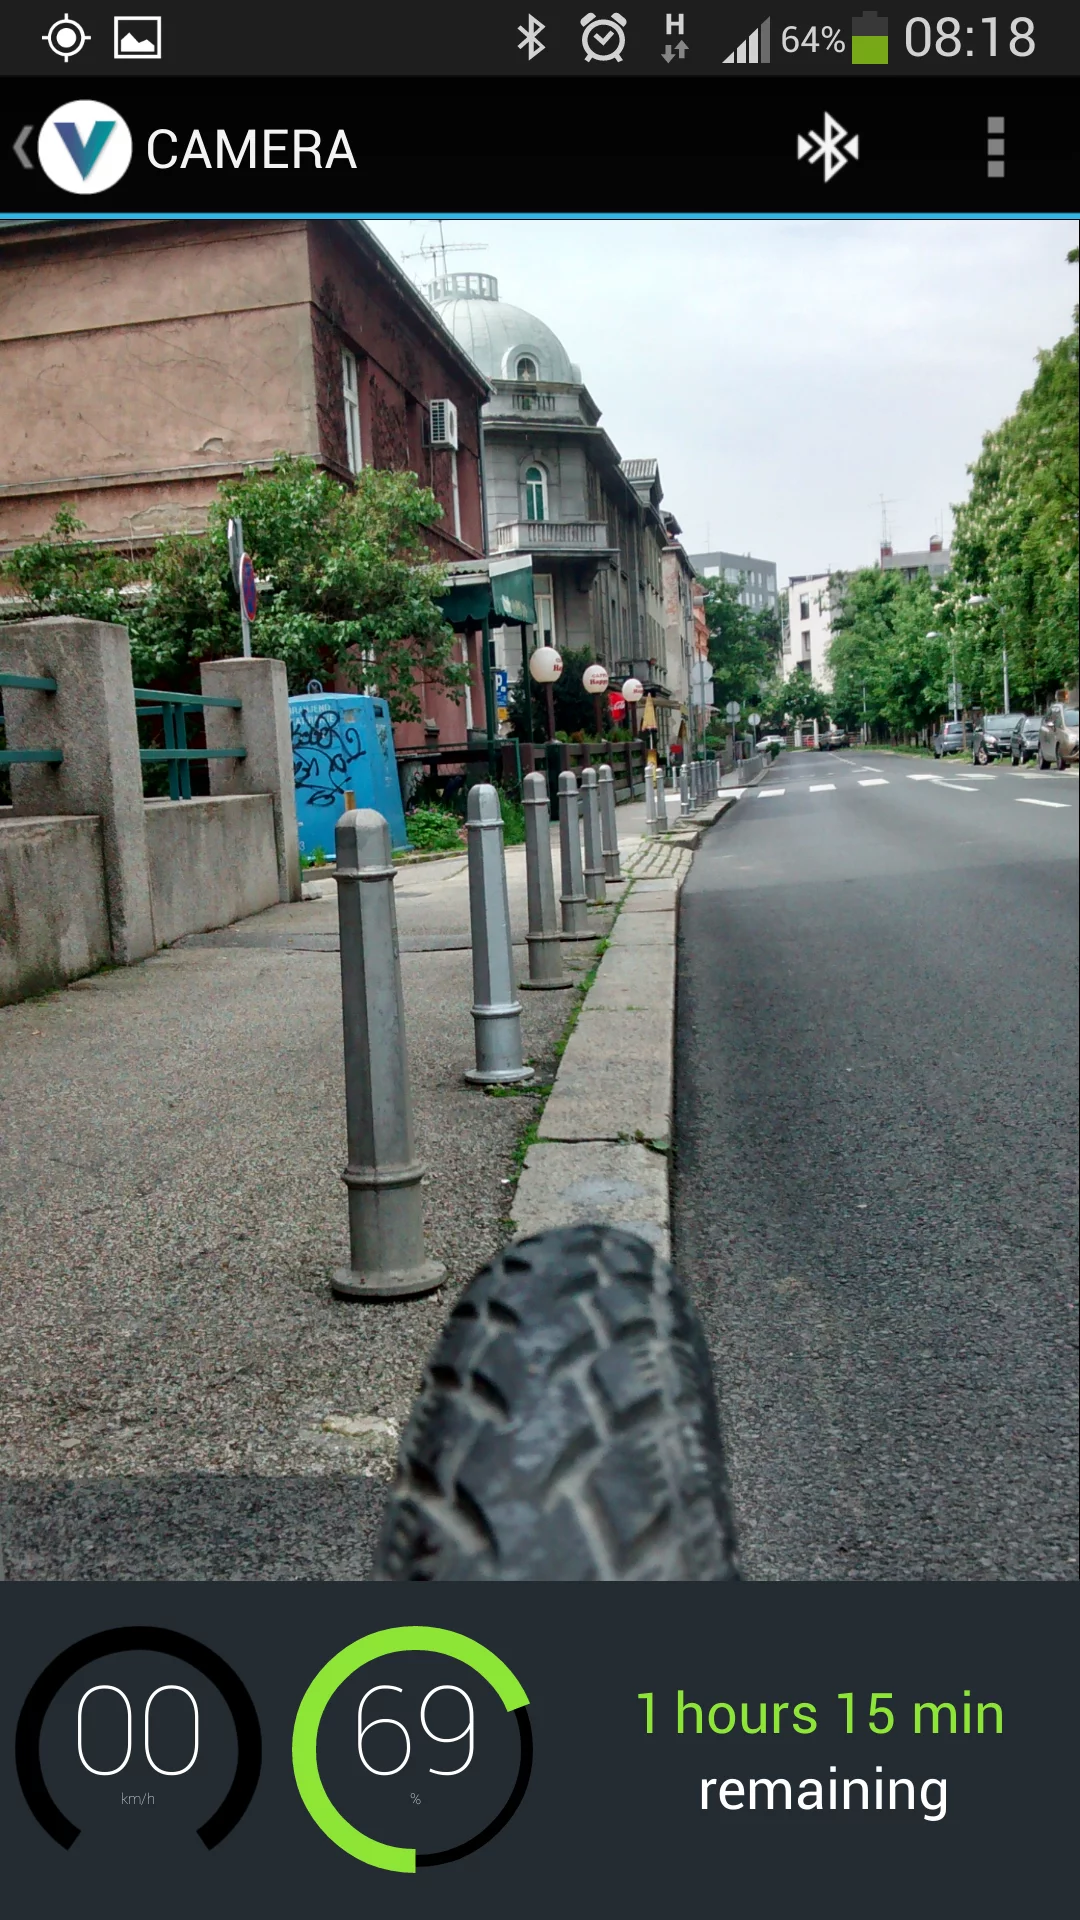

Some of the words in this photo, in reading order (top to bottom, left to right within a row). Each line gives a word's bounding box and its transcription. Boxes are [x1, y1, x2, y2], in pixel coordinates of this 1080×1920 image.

[781, 24, 846, 54] 64%
[904, 16, 1036, 58] 08:18
[147, 128, 358, 170] CAMERA
[76, 1684, 201, 1777] 00
[356, 1684, 476, 1777] 69
[636, 1691, 655, 1735] 1
[677, 1689, 818, 1735] hours
[837, 1691, 895, 1735] 15
[913, 1689, 1004, 1735] min
[121, 1791, 155, 1806] km/h
[410, 1792, 422, 1805] %
[700, 1765, 948, 1822] remaining
